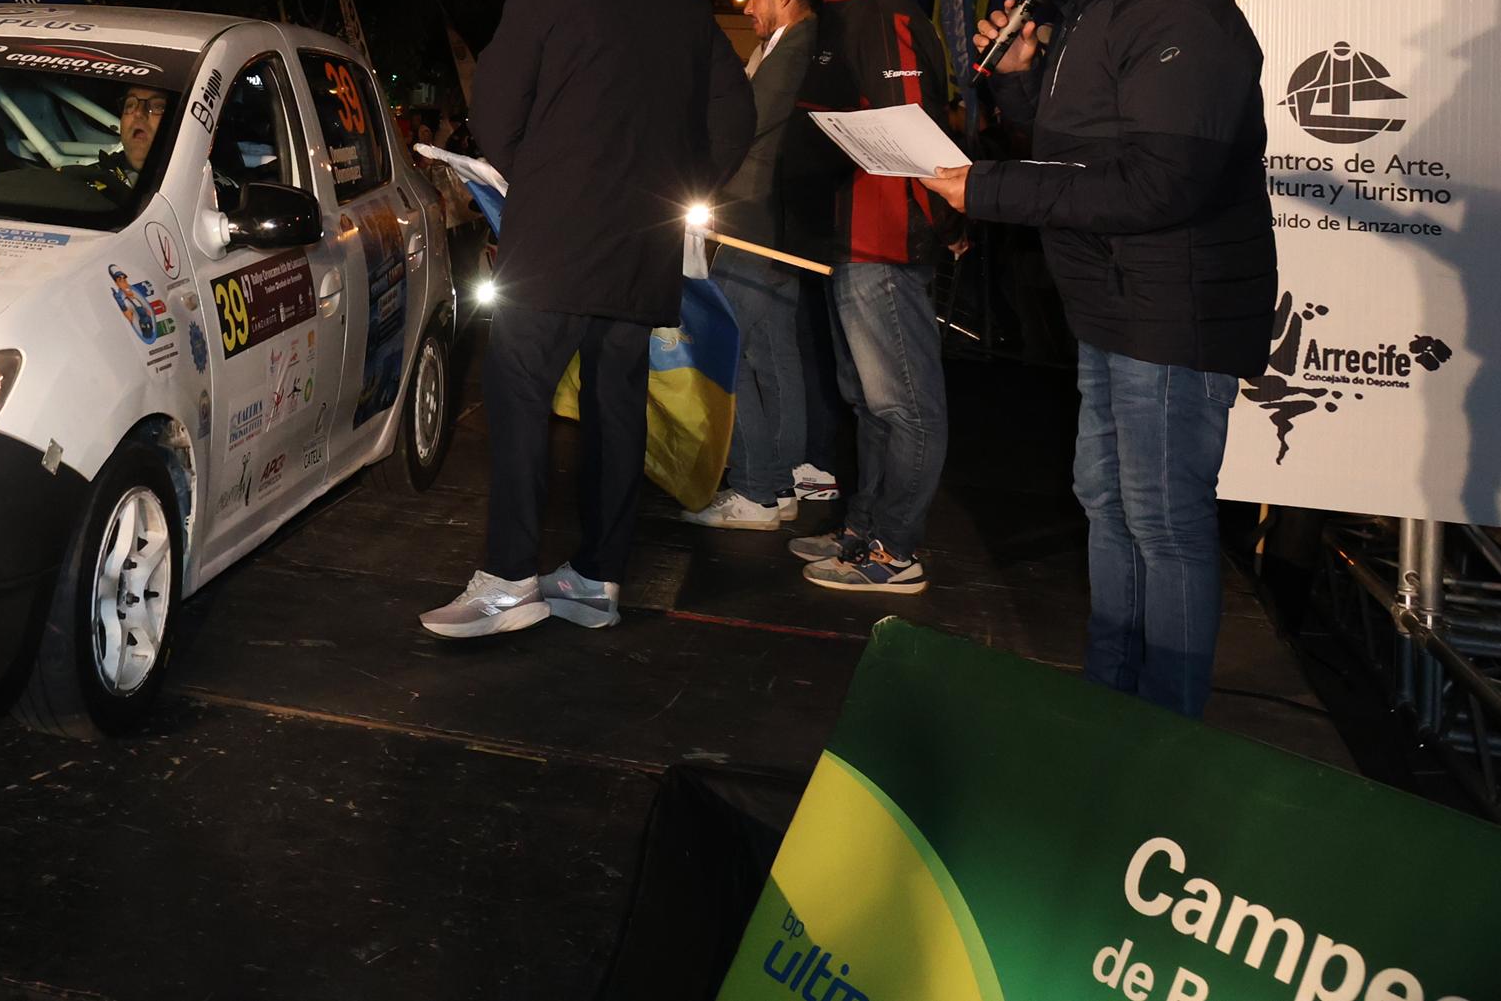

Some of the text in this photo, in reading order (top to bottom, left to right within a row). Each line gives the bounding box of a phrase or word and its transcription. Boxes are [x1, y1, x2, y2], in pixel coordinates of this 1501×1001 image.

[6, 53, 150, 76] CODIGO CERO
[325, 62, 365, 134] 39
[1261, 153, 1451, 179] entros de Arte,
[1270, 176, 1451, 205] ltura y Turismo
[1270, 213, 1442, 235] ildo de Lanzarote
[215, 278, 249, 351] 39
[1303, 339, 1411, 377] Arrecife
[1352, 377, 1365, 385] de
[1366, 378, 1410, 388] Deportes
[783, 907, 804, 940] bp
[1124, 836, 1474, 1001] Campe
[1092, 938, 1154, 1001] de
